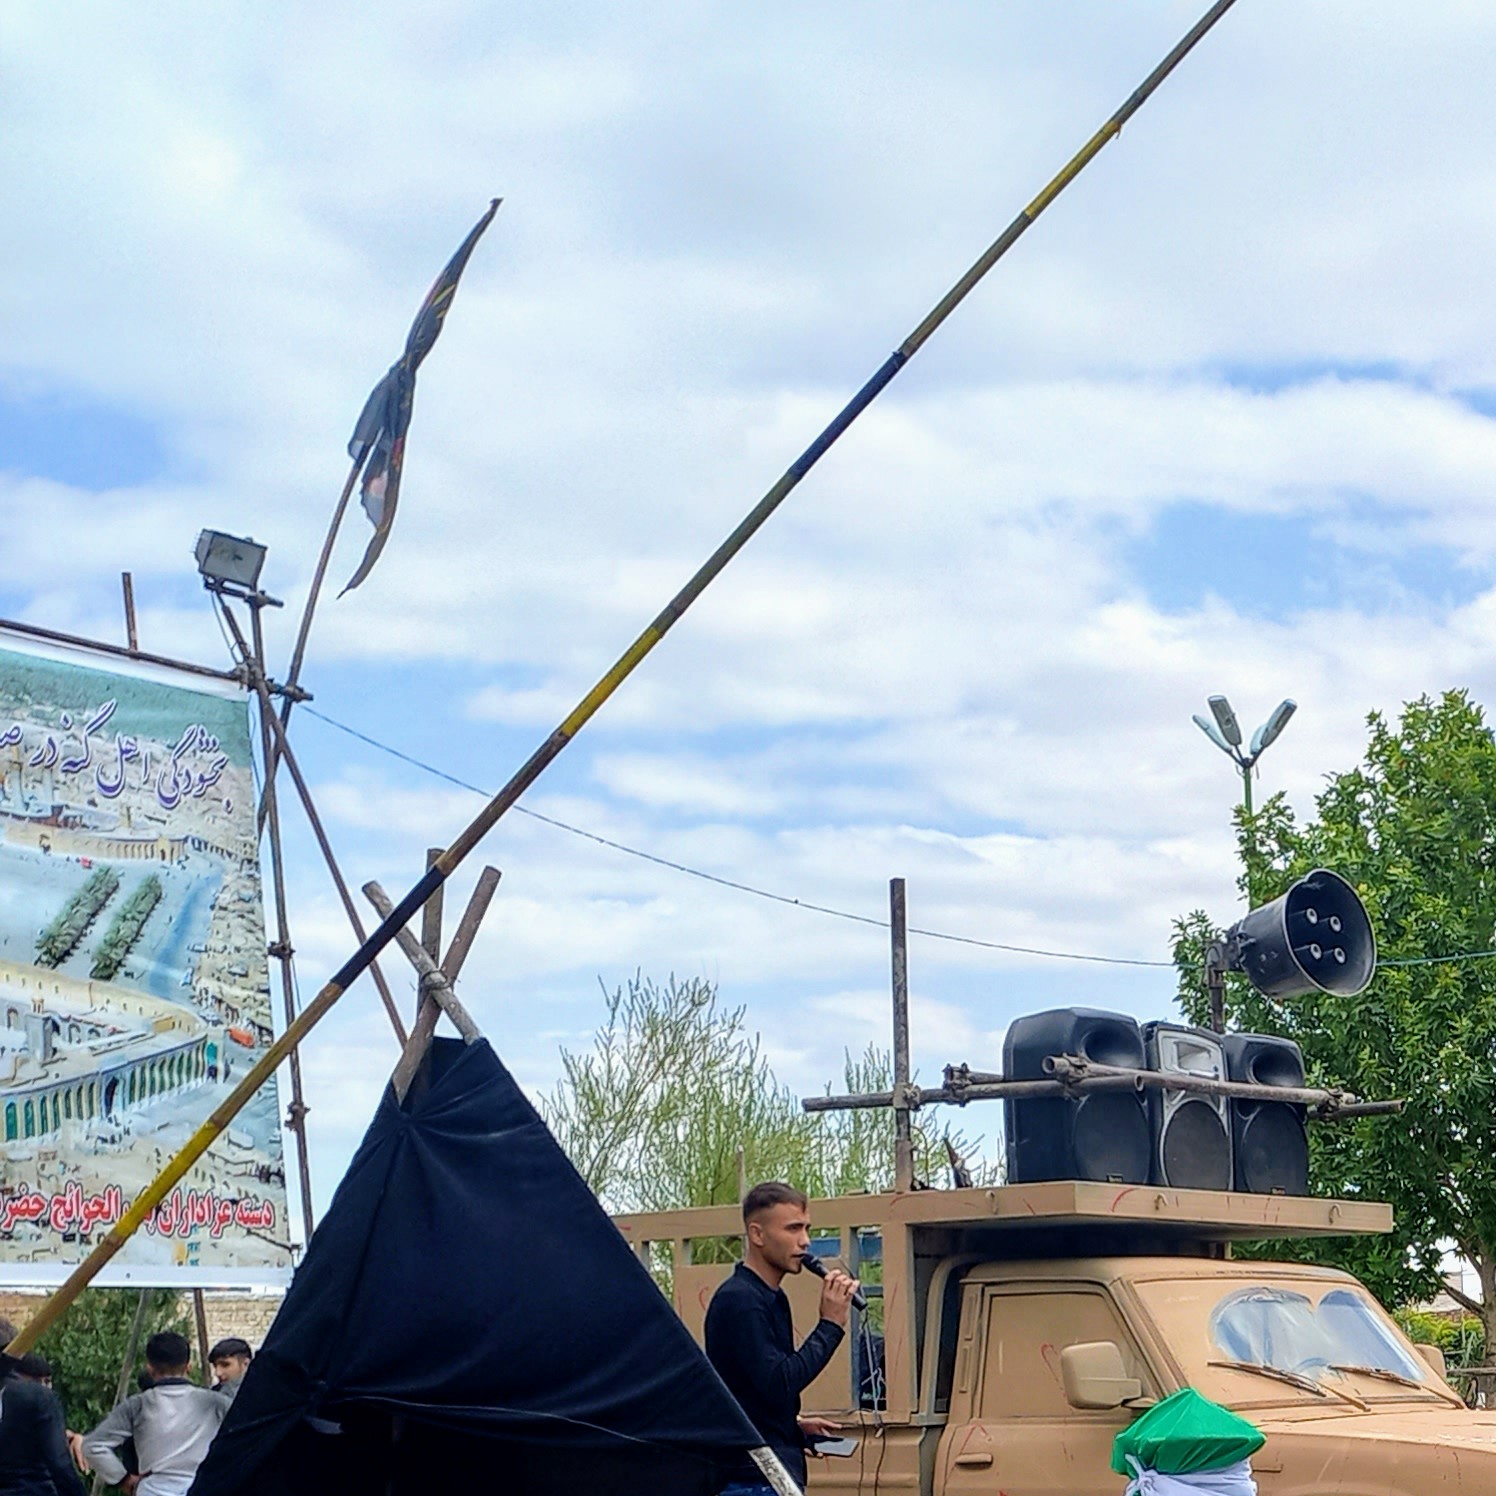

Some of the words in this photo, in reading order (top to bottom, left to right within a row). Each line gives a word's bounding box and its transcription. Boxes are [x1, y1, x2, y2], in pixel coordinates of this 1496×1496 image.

[95, 731, 150, 799] اهل
[0, 1182, 48, 1232] حضر
[157, 1187, 233, 1239] عزاداران
[234, 1198, 275, 1229] دسته
